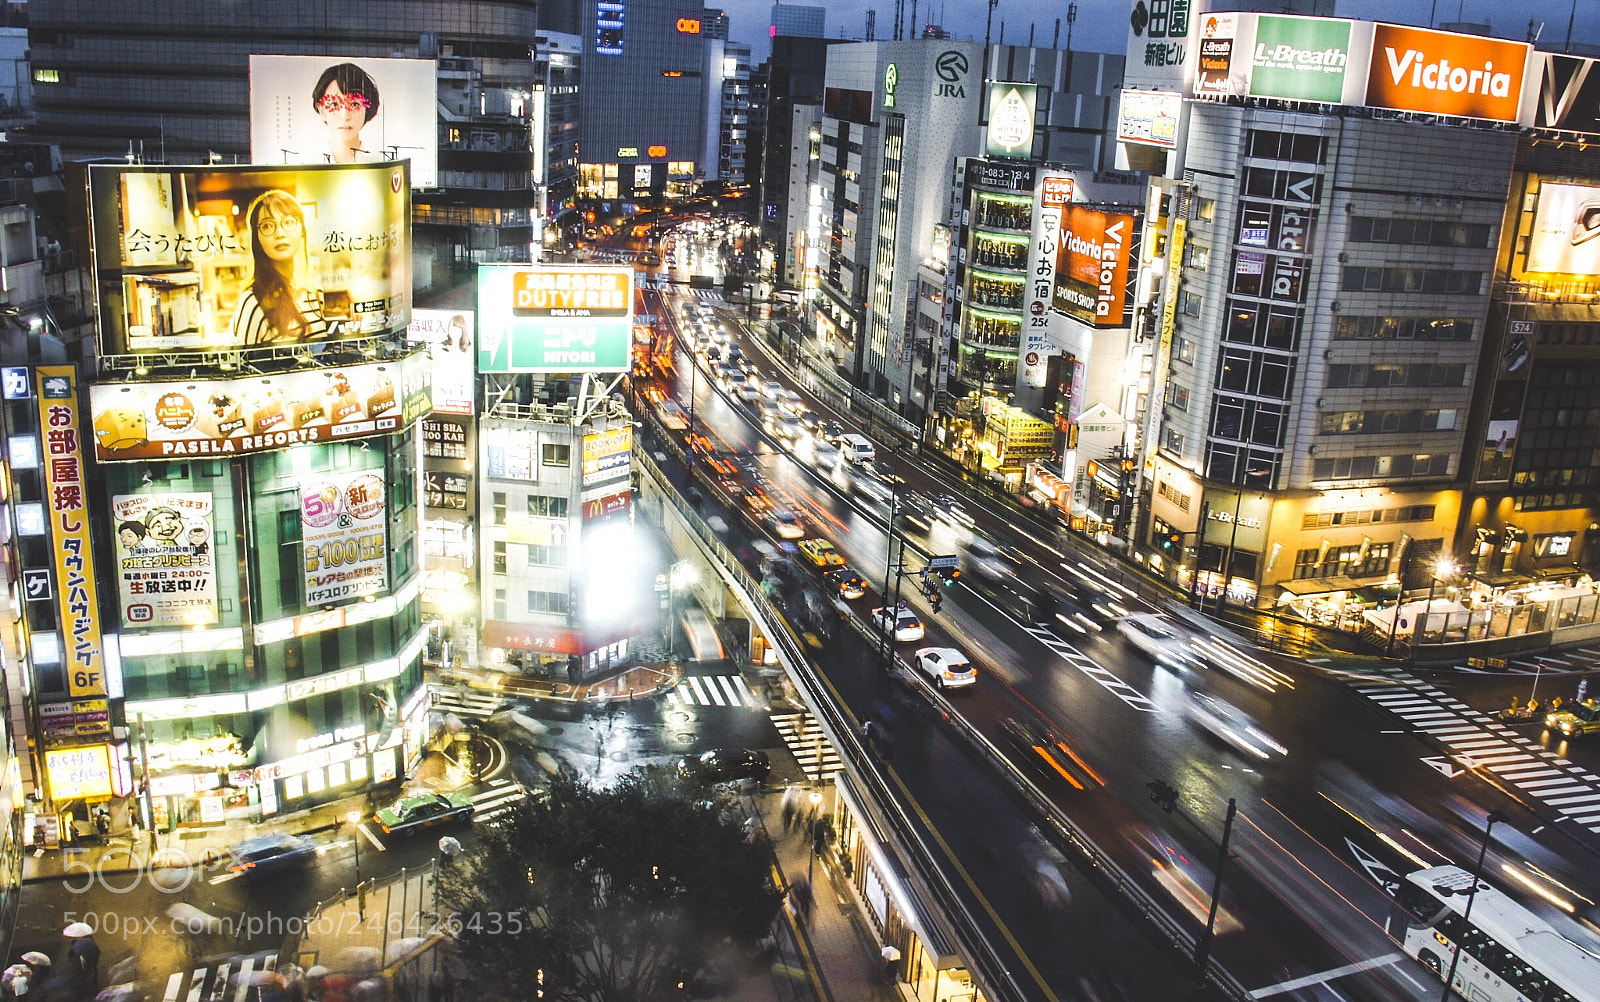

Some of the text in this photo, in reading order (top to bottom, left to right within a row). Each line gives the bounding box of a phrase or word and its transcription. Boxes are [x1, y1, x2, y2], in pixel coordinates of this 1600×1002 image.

[1147, 0, 1191, 38] 田園
[1144, 42, 1186, 66] 新宿ビル
[1202, 41, 1231, 52] L-Breath
[1254, 42, 1348, 66] L-Breath
[1201, 57, 1229, 70] Victoria
[1385, 47, 1511, 98] Victoria
[934, 84, 967, 98] JRA
[126, 228, 247, 253] 会うたびに、
[1060, 228, 1102, 260] Victoria
[1273, 176, 1315, 296] Victoria
[1034, 213, 1058, 299] 安心お宿
[1096, 220, 1125, 316] Victoria
[1056, 285, 1096, 310] SPORTS SHOP
[1514, 322, 1531, 333] 574
[543, 350, 596, 363] NITORI
[301, 410, 321, 421] バナナ
[379, 418, 394, 429] 検索
[423, 422, 464, 432] SHI SHA
[162, 427, 319, 455] PASELA RESORTS
[443, 432, 464, 442] KAH
[48, 405, 82, 533] お部屋探し
[303, 493, 336, 517] 5円
[348, 484, 368, 507] 新
[1207, 509, 1262, 530] L-Breath
[319, 538, 360, 568] 100
[124, 572, 168, 580] 毎週水曜日
[130, 579, 207, 596] 生放送中!!
[63, 538, 99, 667] タウンハウジング
[74, 671, 100, 688] 6F
